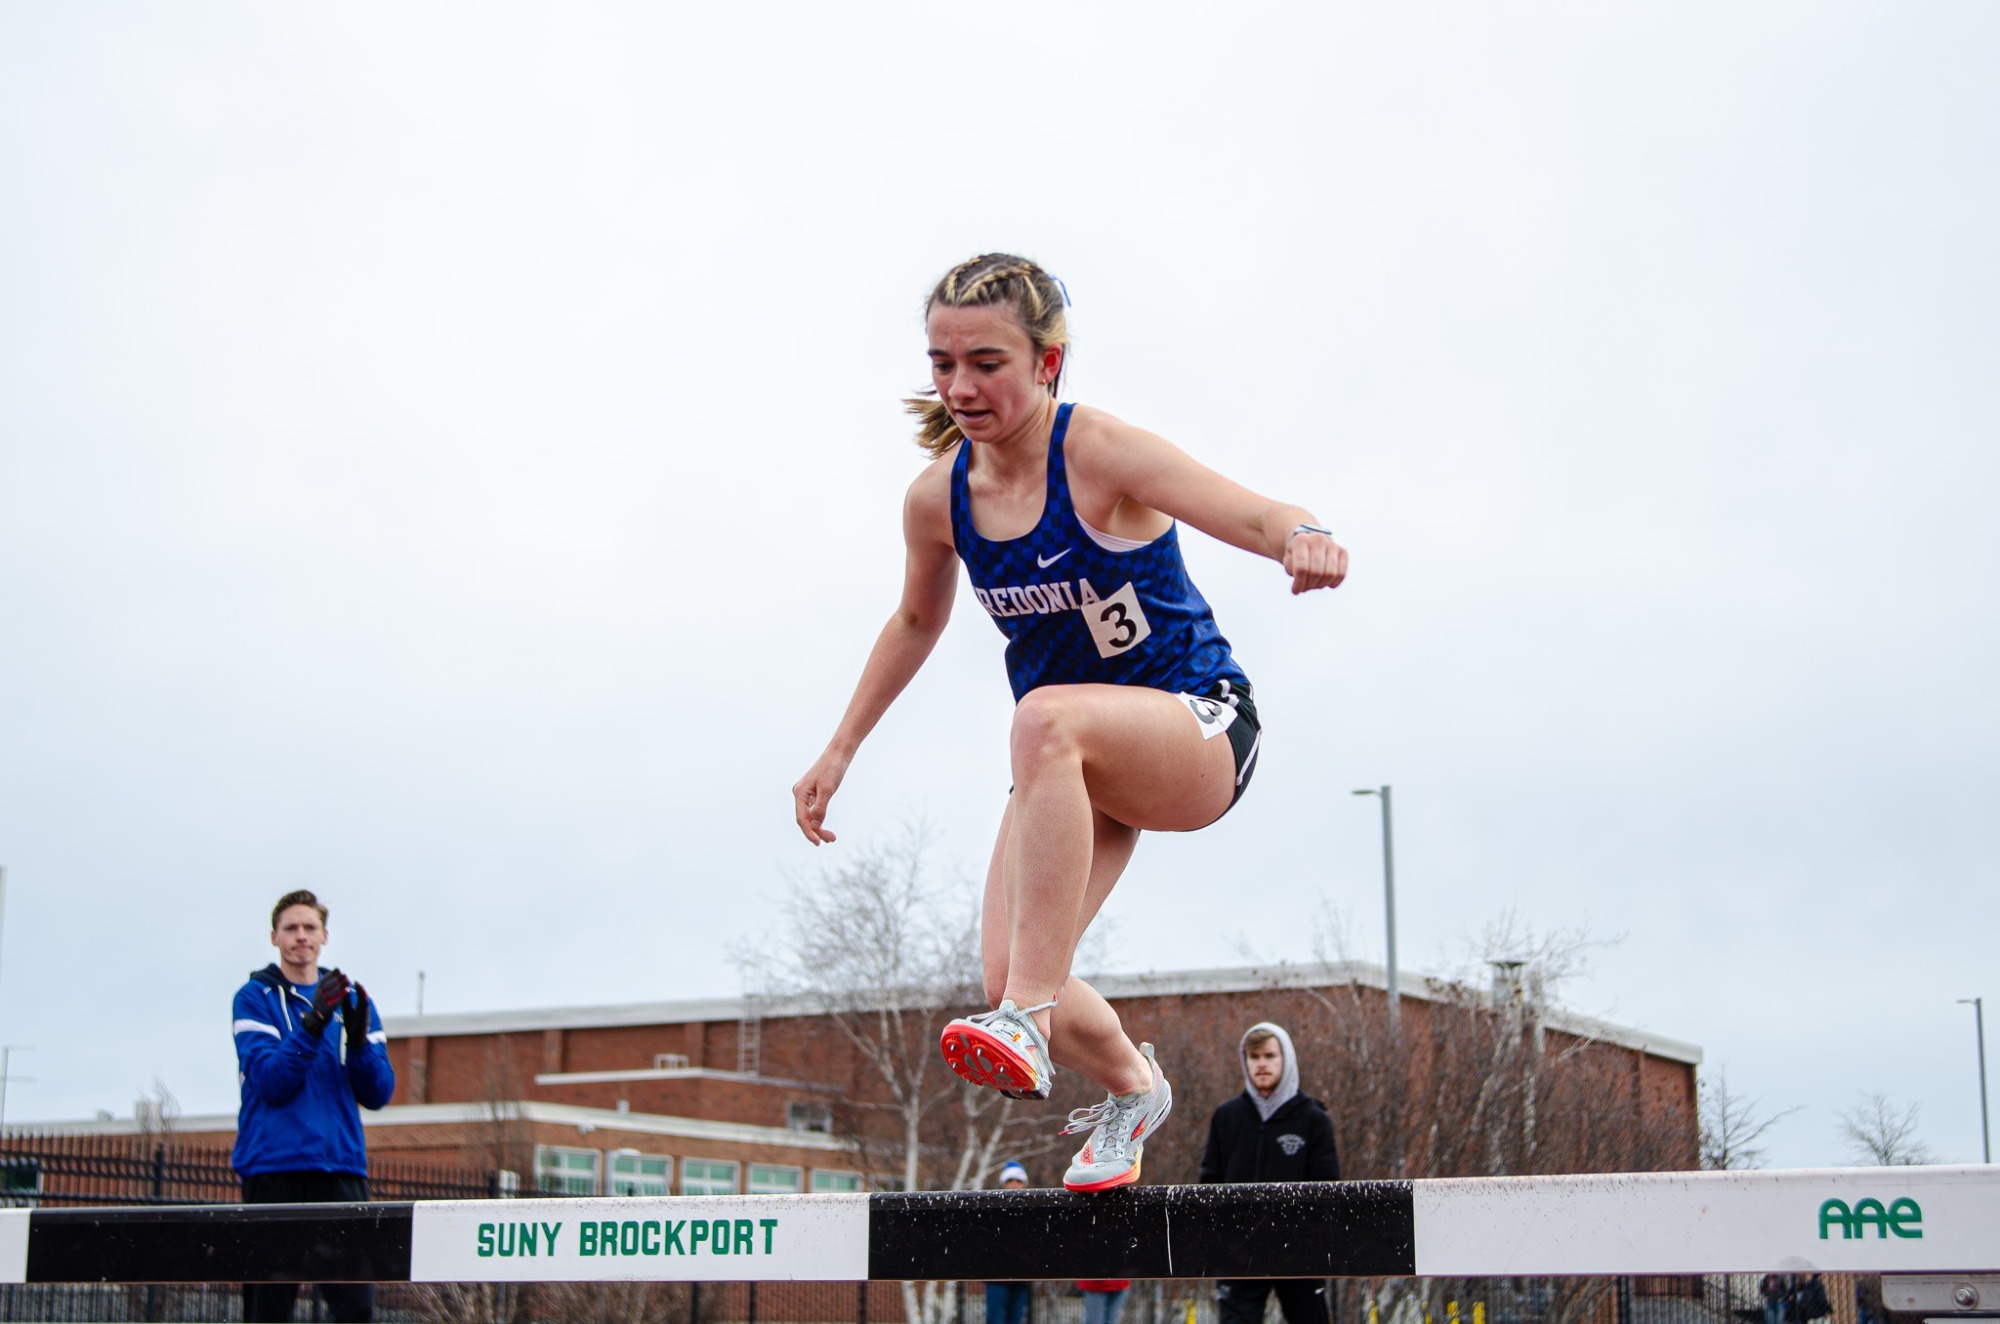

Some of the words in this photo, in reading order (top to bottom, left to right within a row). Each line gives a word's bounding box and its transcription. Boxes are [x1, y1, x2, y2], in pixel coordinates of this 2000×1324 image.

[974, 578, 1101, 617] REDONIA
[1100, 602, 1137, 648] 3
[477, 1222, 562, 1257] SUNY
[579, 1219, 778, 1257] BROCKPORT
